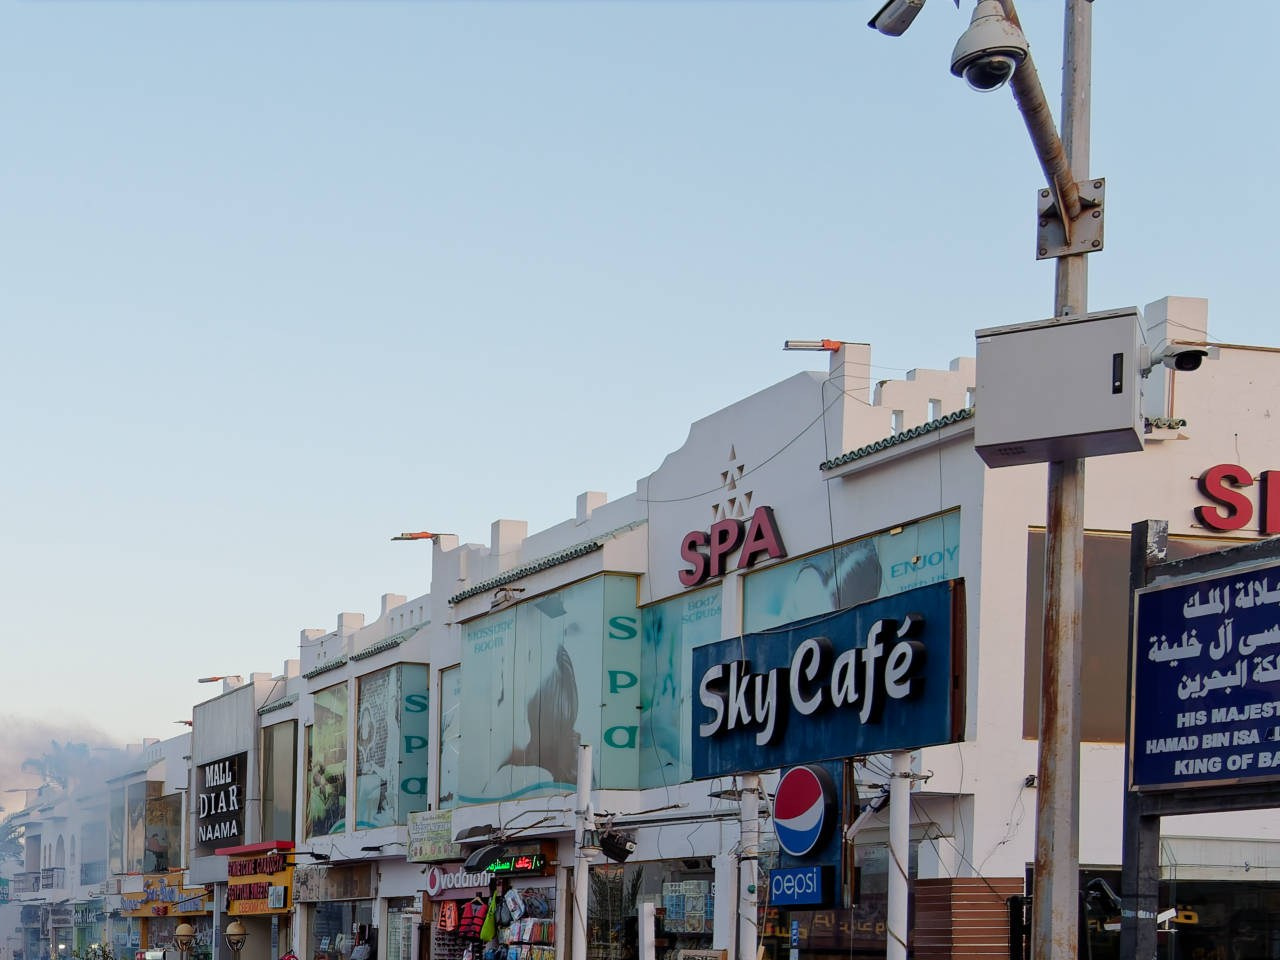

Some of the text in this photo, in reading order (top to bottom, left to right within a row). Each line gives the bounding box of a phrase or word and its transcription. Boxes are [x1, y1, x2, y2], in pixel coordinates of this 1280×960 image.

[678, 505, 787, 587] SPA
[890, 544, 959, 578] ENJOY
[699, 615, 918, 746] Sky Café
[1177, 710, 1207, 728] HIS
[1146, 736, 1199, 754] HAMAD
[1202, 732, 1230, 749] BIN
[1233, 729, 1260, 746] ISA
[205, 761, 232, 788] MALL
[1174, 757, 1222, 775] KING
[1226, 753, 1254, 771] OF
[199, 785, 238, 818] DIAR
[198, 819, 238, 842] NAAMA
[772, 867, 817, 901] pepsi
